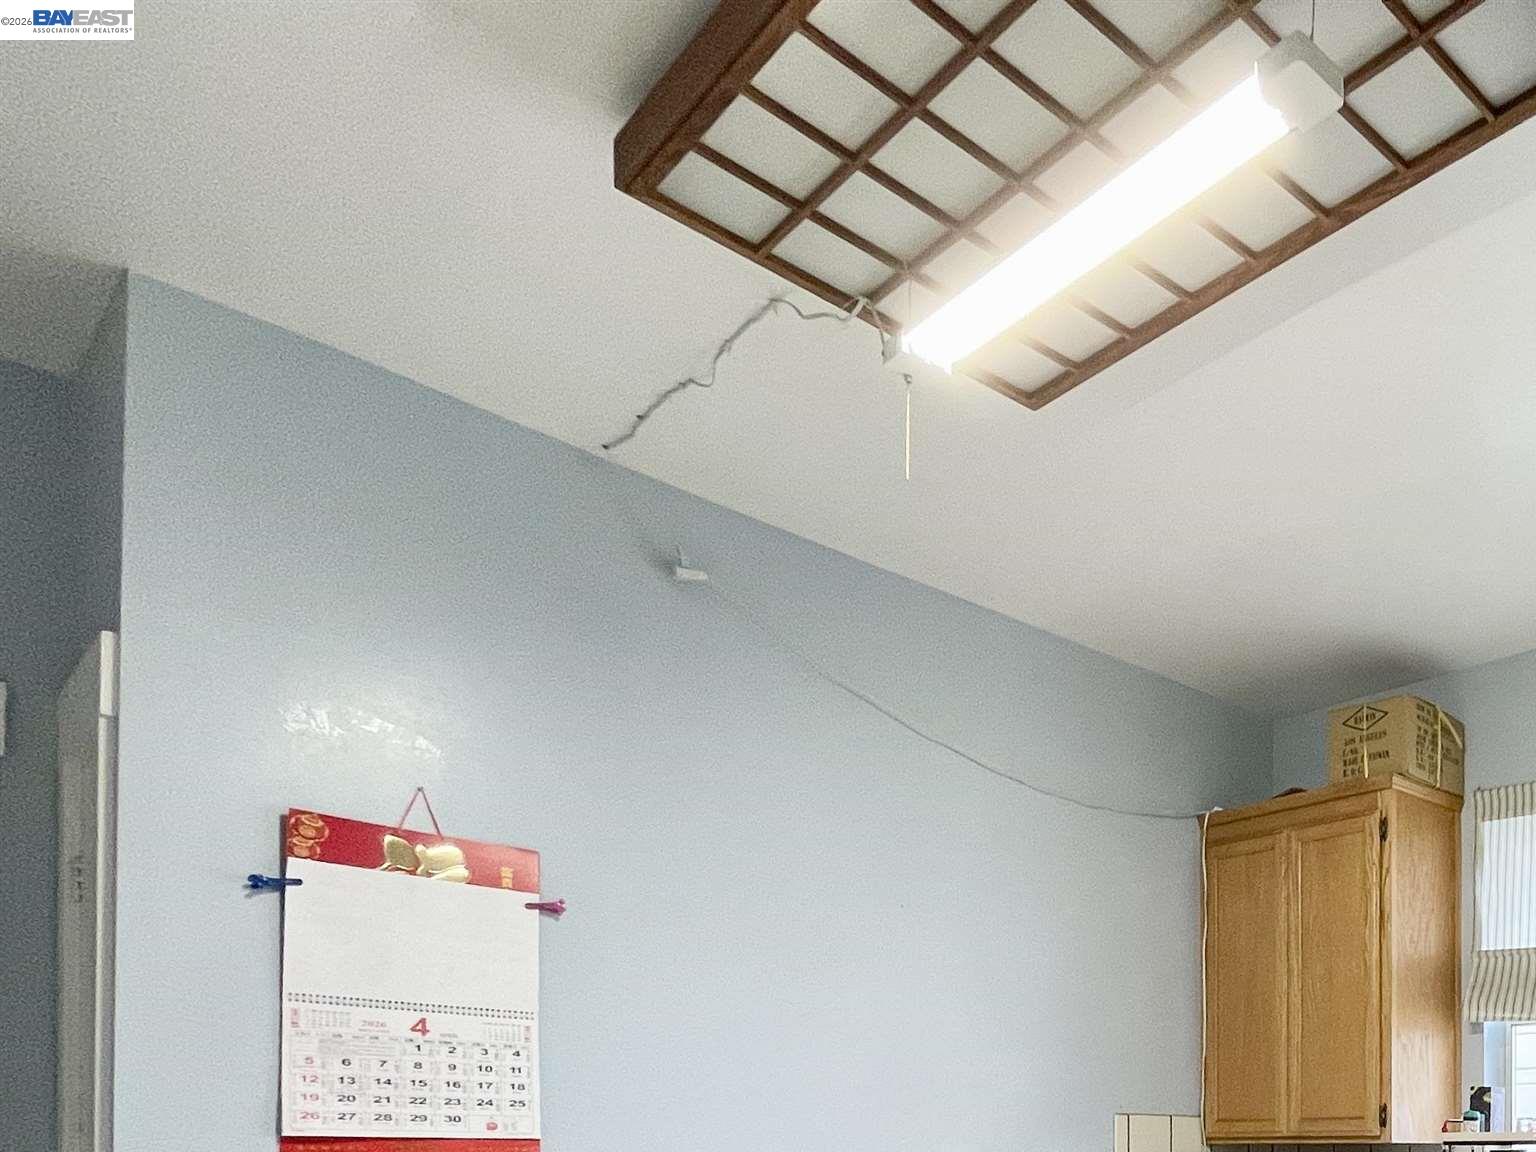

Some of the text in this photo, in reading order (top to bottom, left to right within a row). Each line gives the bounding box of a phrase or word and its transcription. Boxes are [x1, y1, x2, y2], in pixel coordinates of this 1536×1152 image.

[410, 1017, 430, 1036] 4
[477, 1064, 493, 1072] 10
[301, 1075, 319, 1083] 12
[338, 1076, 356, 1085] 13
[410, 1079, 428, 1087] 15
[445, 1081, 461, 1089] 16
[510, 1083, 526, 1091] 18
[337, 1094, 356, 1102] 20
[373, 1096, 391, 1104] 21
[408, 1097, 427, 1105] 22
[443, 1098, 461, 1106] 23
[508, 1100, 526, 1108] 25
[301, 1112, 320, 1120] 26
[337, 1112, 356, 1120] 27
[373, 1113, 392, 1121] 28
[443, 1115, 462, 1123] 30
